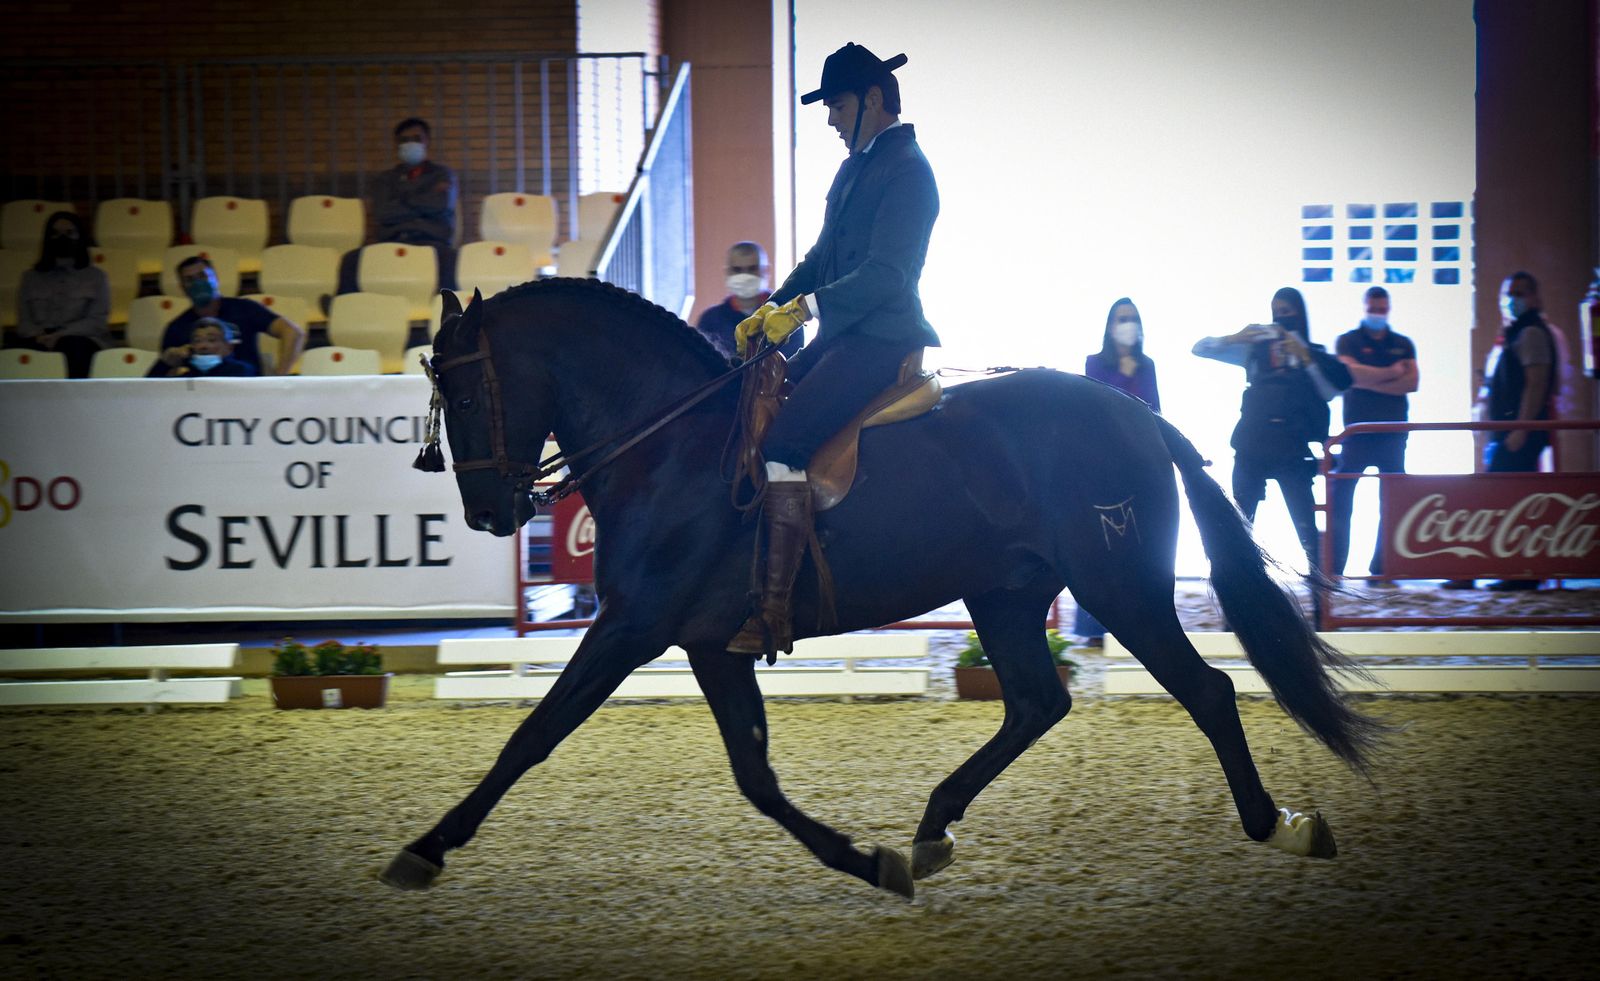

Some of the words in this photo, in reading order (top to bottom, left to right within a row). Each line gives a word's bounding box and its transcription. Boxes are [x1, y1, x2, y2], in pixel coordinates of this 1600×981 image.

[172, 412, 261, 447] CITY
[269, 416, 432, 445] COUNCI
[285, 460, 334, 490] OF
[165, 504, 453, 571] SEVILLE
[1393, 491, 1600, 559] Coca-Cola
